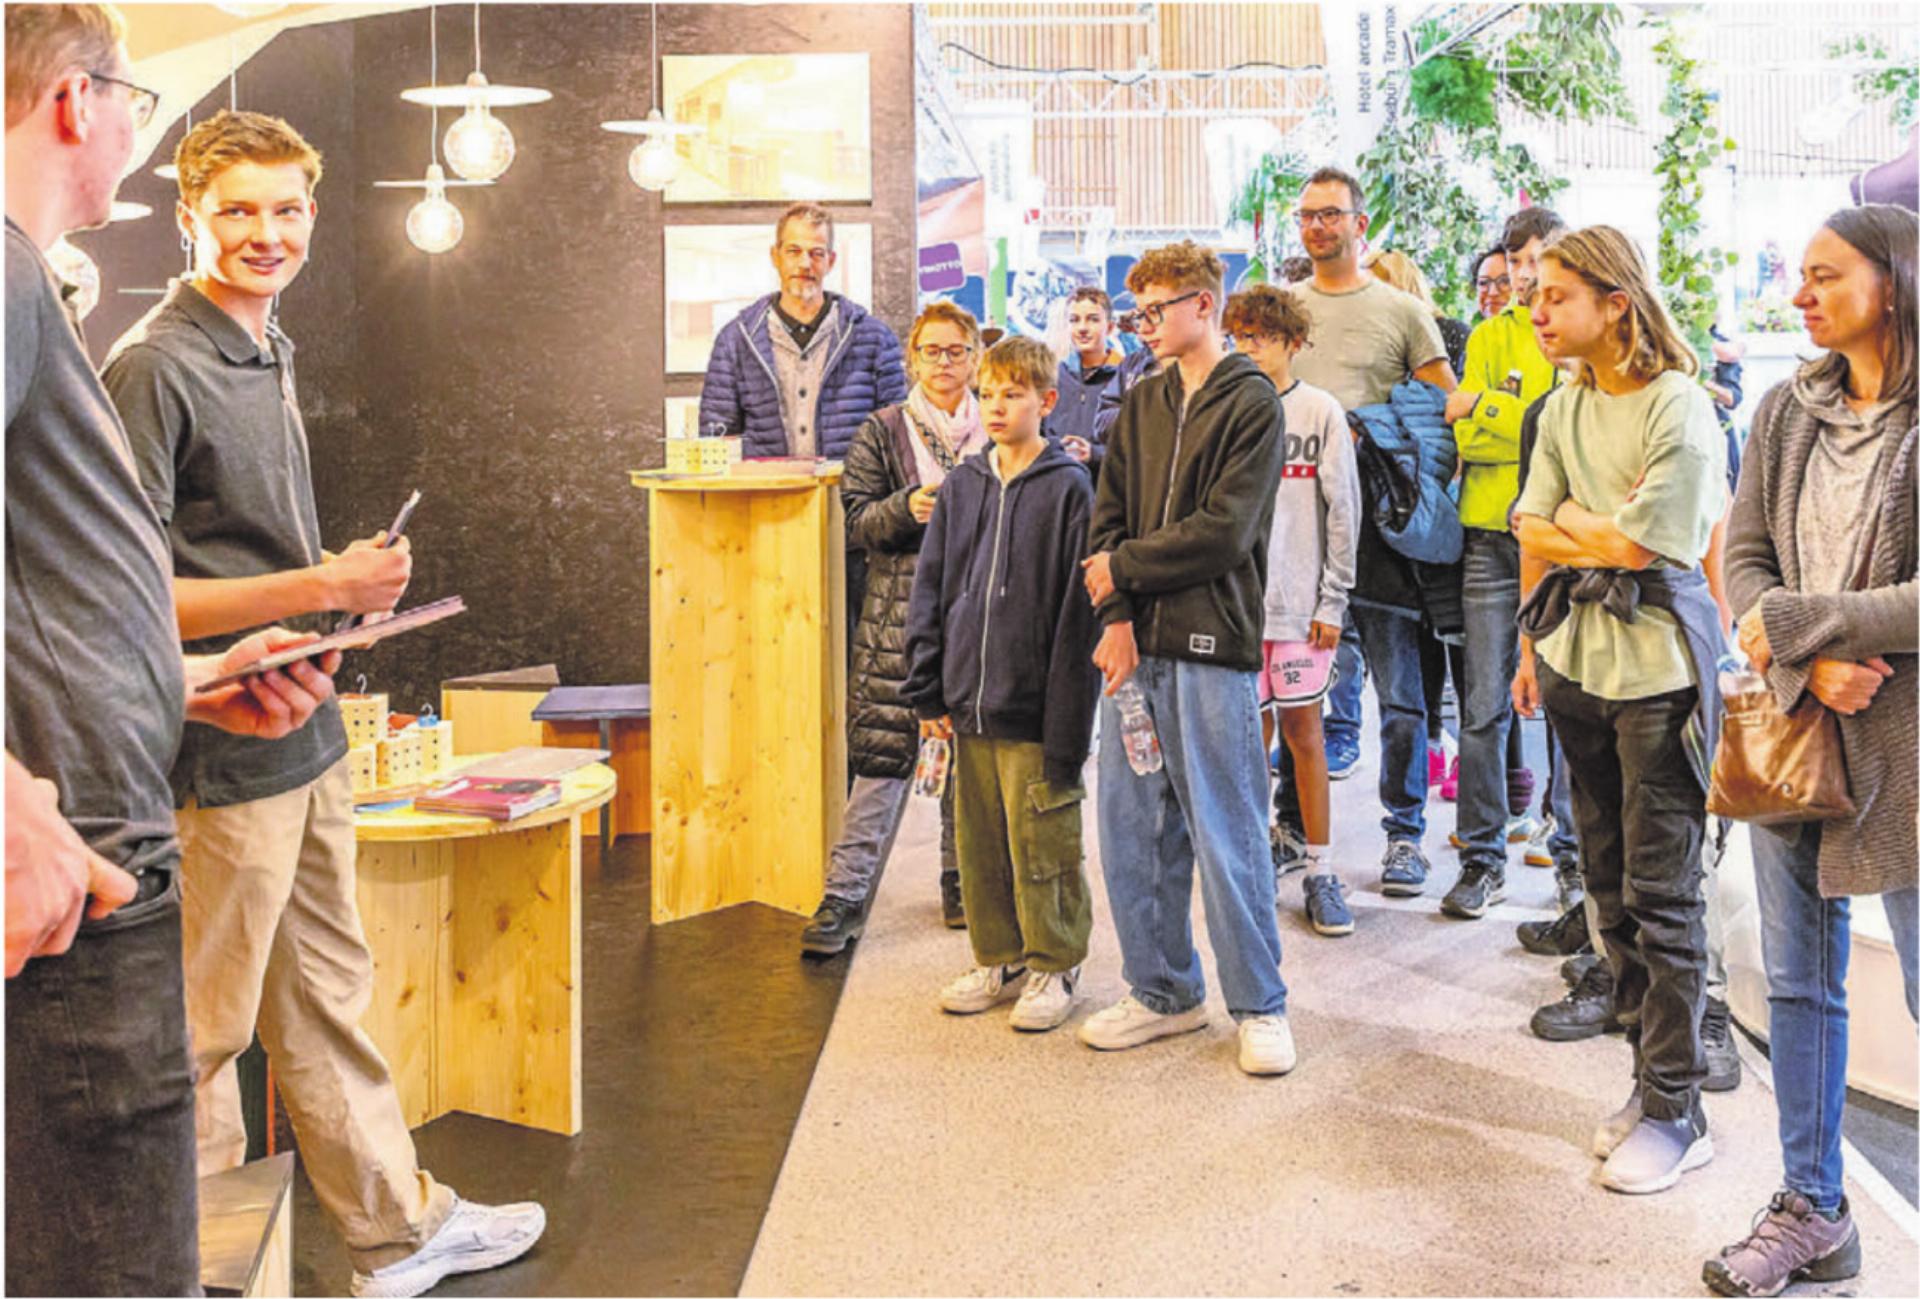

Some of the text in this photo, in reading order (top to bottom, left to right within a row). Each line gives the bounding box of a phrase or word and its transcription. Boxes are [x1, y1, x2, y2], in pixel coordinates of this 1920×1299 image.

[1357, 12, 1371, 113] Hotel arcade
[1383, 4, 1396, 64] Tramax
[1284, 670, 1301, 685] 32
